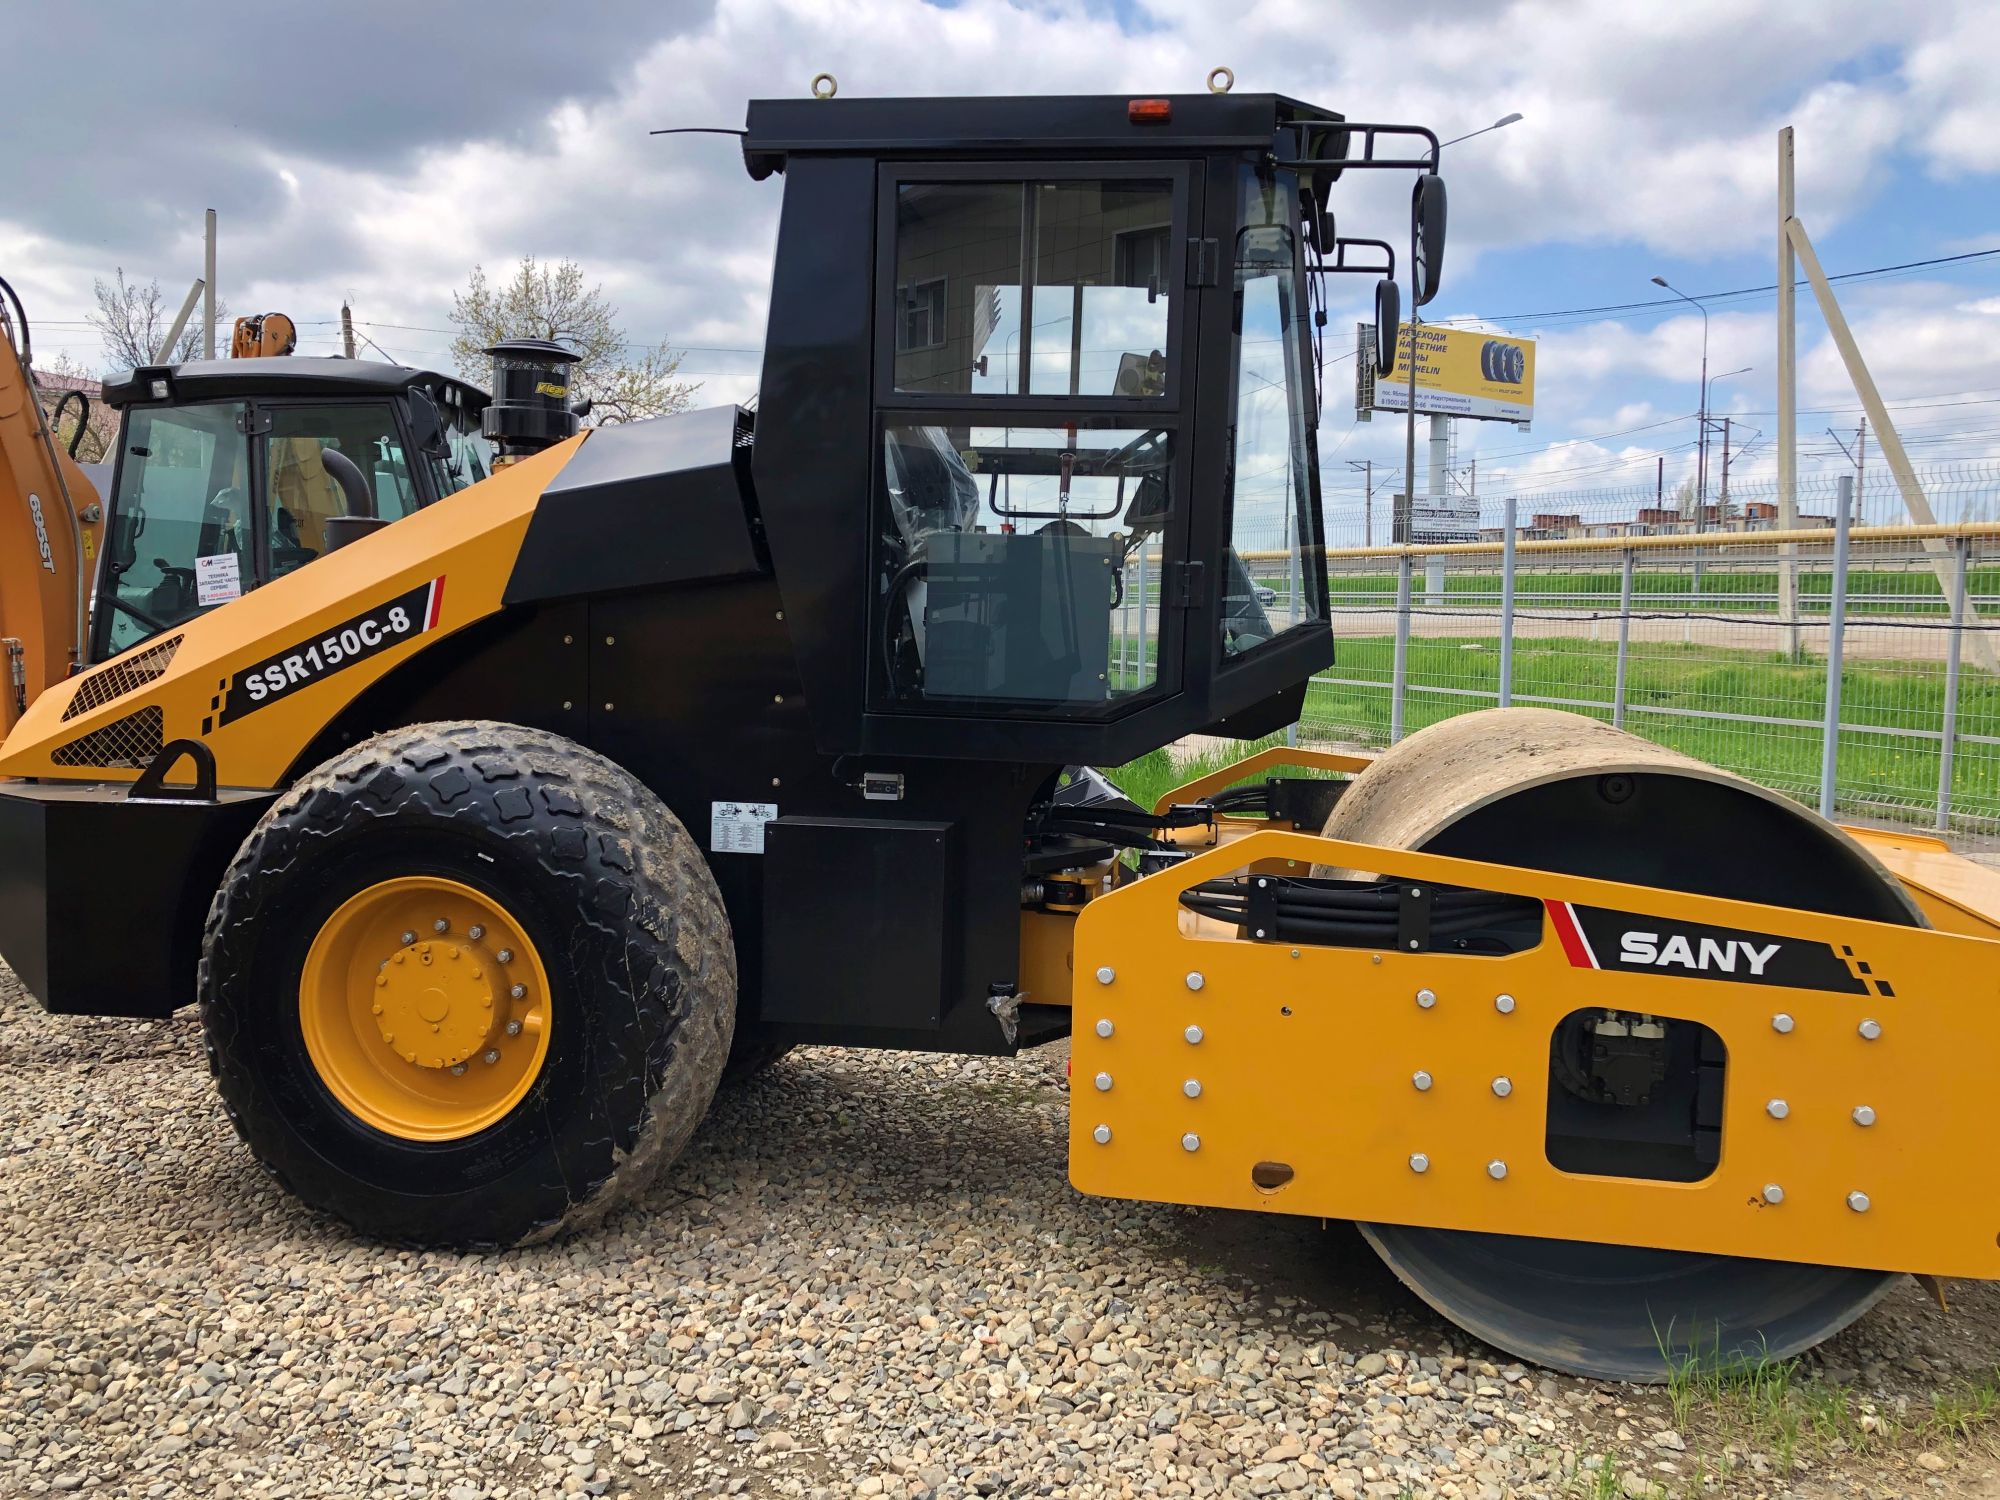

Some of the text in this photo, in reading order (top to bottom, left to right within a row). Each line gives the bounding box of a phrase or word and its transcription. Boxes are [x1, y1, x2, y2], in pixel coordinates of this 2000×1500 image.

[1399, 328, 1447, 342] ПЕЕХОДИ
[1398, 363, 1441, 375] MIHELIN
[29, 493, 56, 574] 695ST
[245, 606, 411, 701] SSR150C-8
[1620, 931, 1782, 976] SANY
